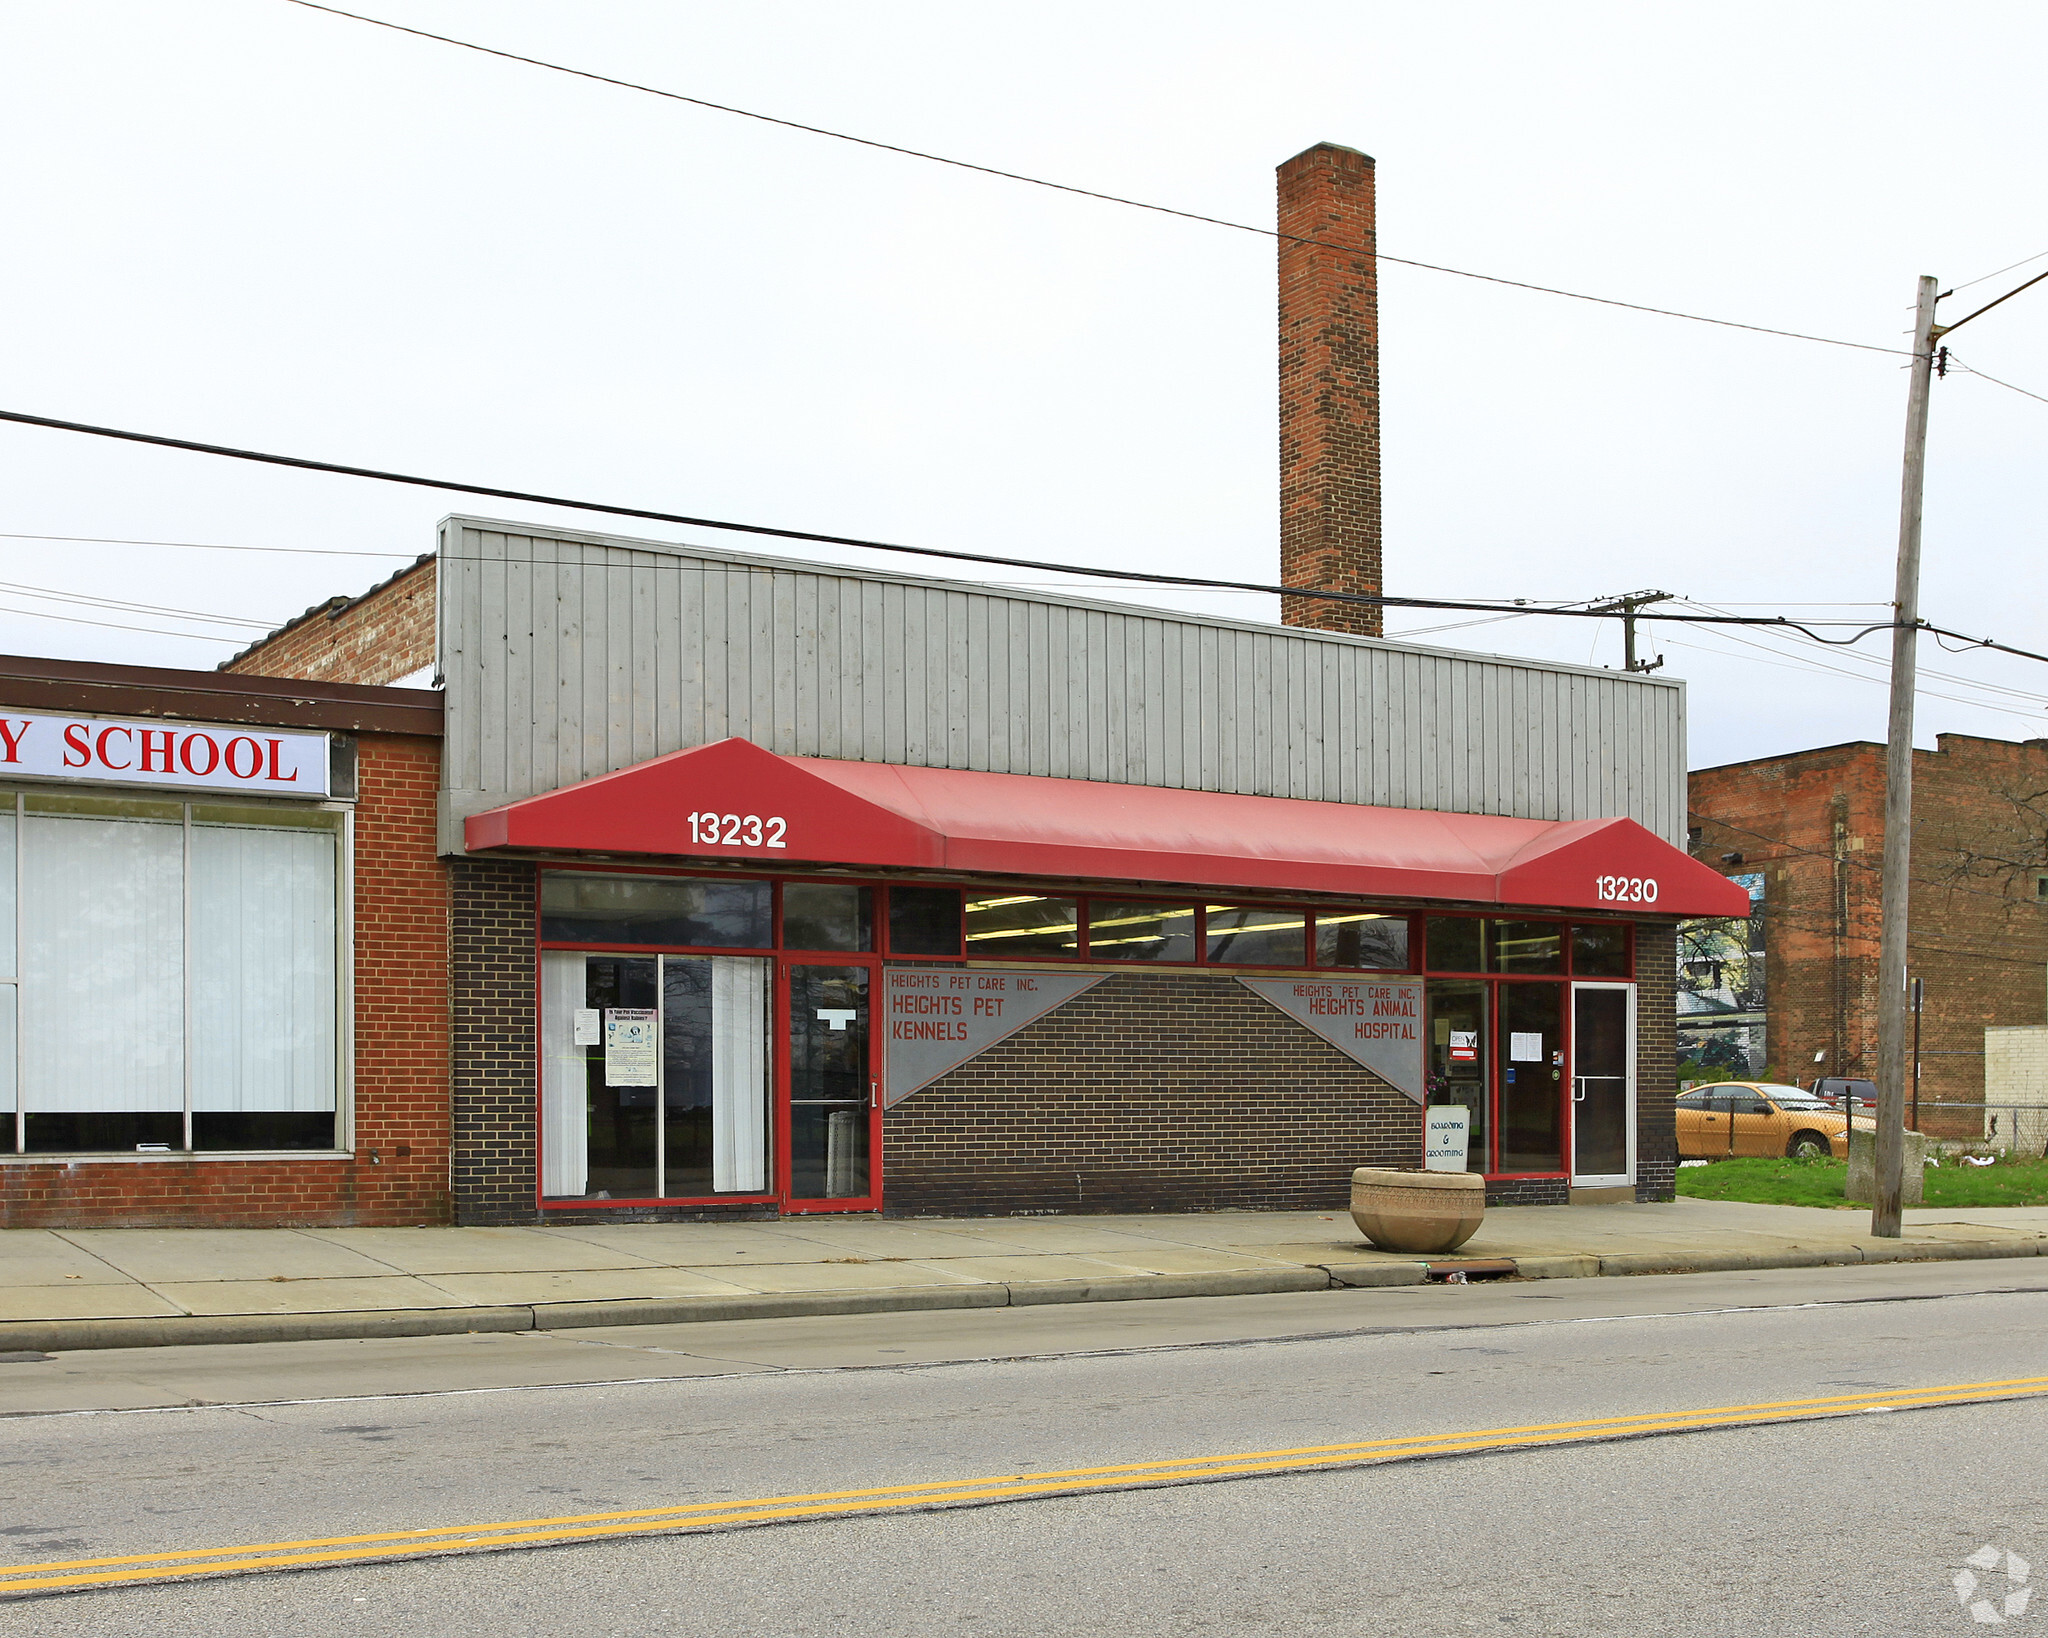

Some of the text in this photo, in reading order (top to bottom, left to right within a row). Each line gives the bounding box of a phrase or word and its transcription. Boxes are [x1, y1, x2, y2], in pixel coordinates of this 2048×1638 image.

[63, 723, 298, 782] SCHOOL
[687, 811, 787, 849] 13232
[1596, 875, 1658, 903] 13230
[891, 974, 1038, 991] HEIGHTS PET CARE INC.
[1293, 985, 1416, 1000] HEIGHTS PET CARE INC.
[892, 994, 1005, 1017] HEIGHTS PET
[1309, 998, 1417, 1018] HEIGHTS ANIMAL
[892, 1020, 968, 1041] KENNELS
[1355, 1022, 1417, 1040] HOSPITAL
